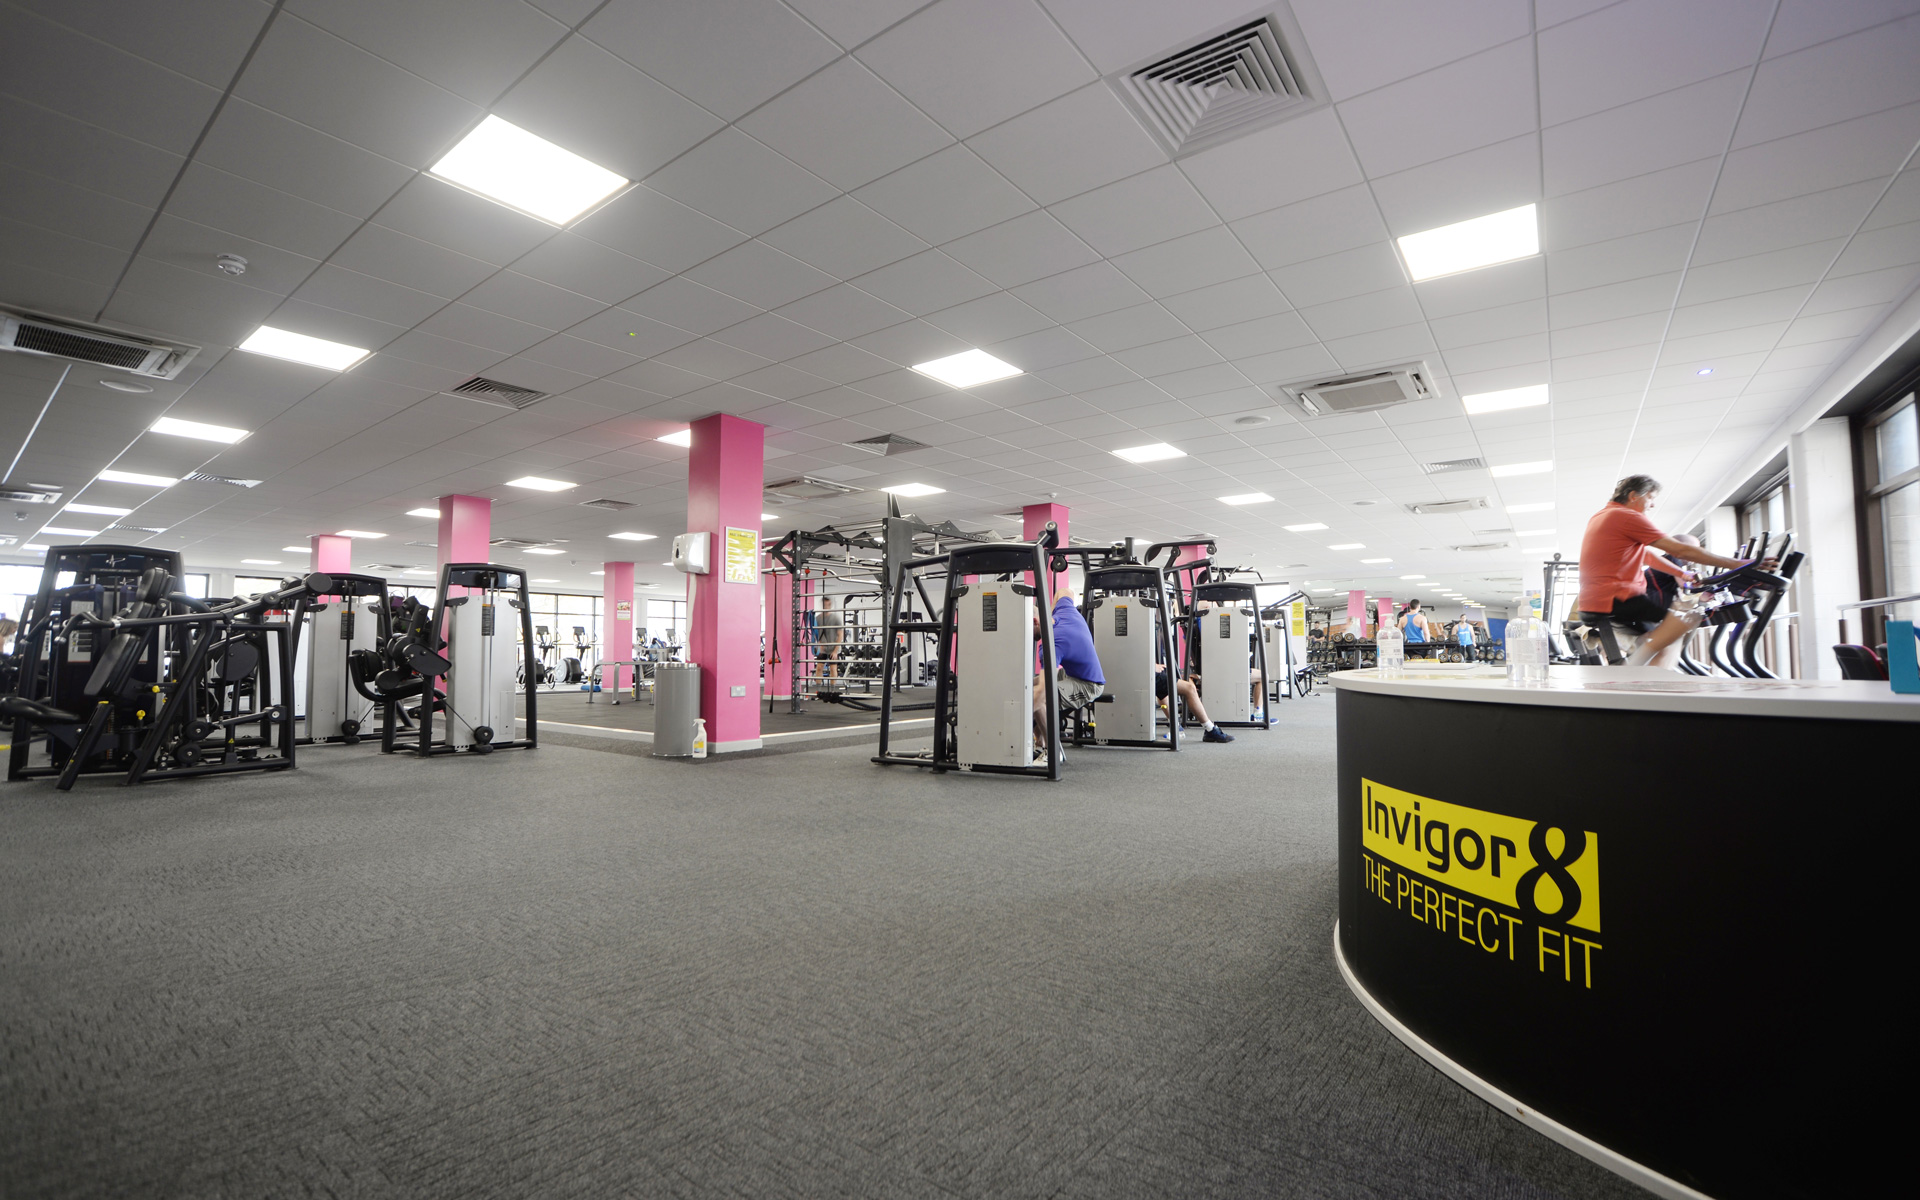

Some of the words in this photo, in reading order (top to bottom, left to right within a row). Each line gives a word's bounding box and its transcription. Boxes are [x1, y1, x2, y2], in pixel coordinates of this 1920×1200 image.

[1363, 853, 1392, 905] THE
[1397, 873, 1523, 961] PERFECT
[1538, 926, 1603, 989] FIT
